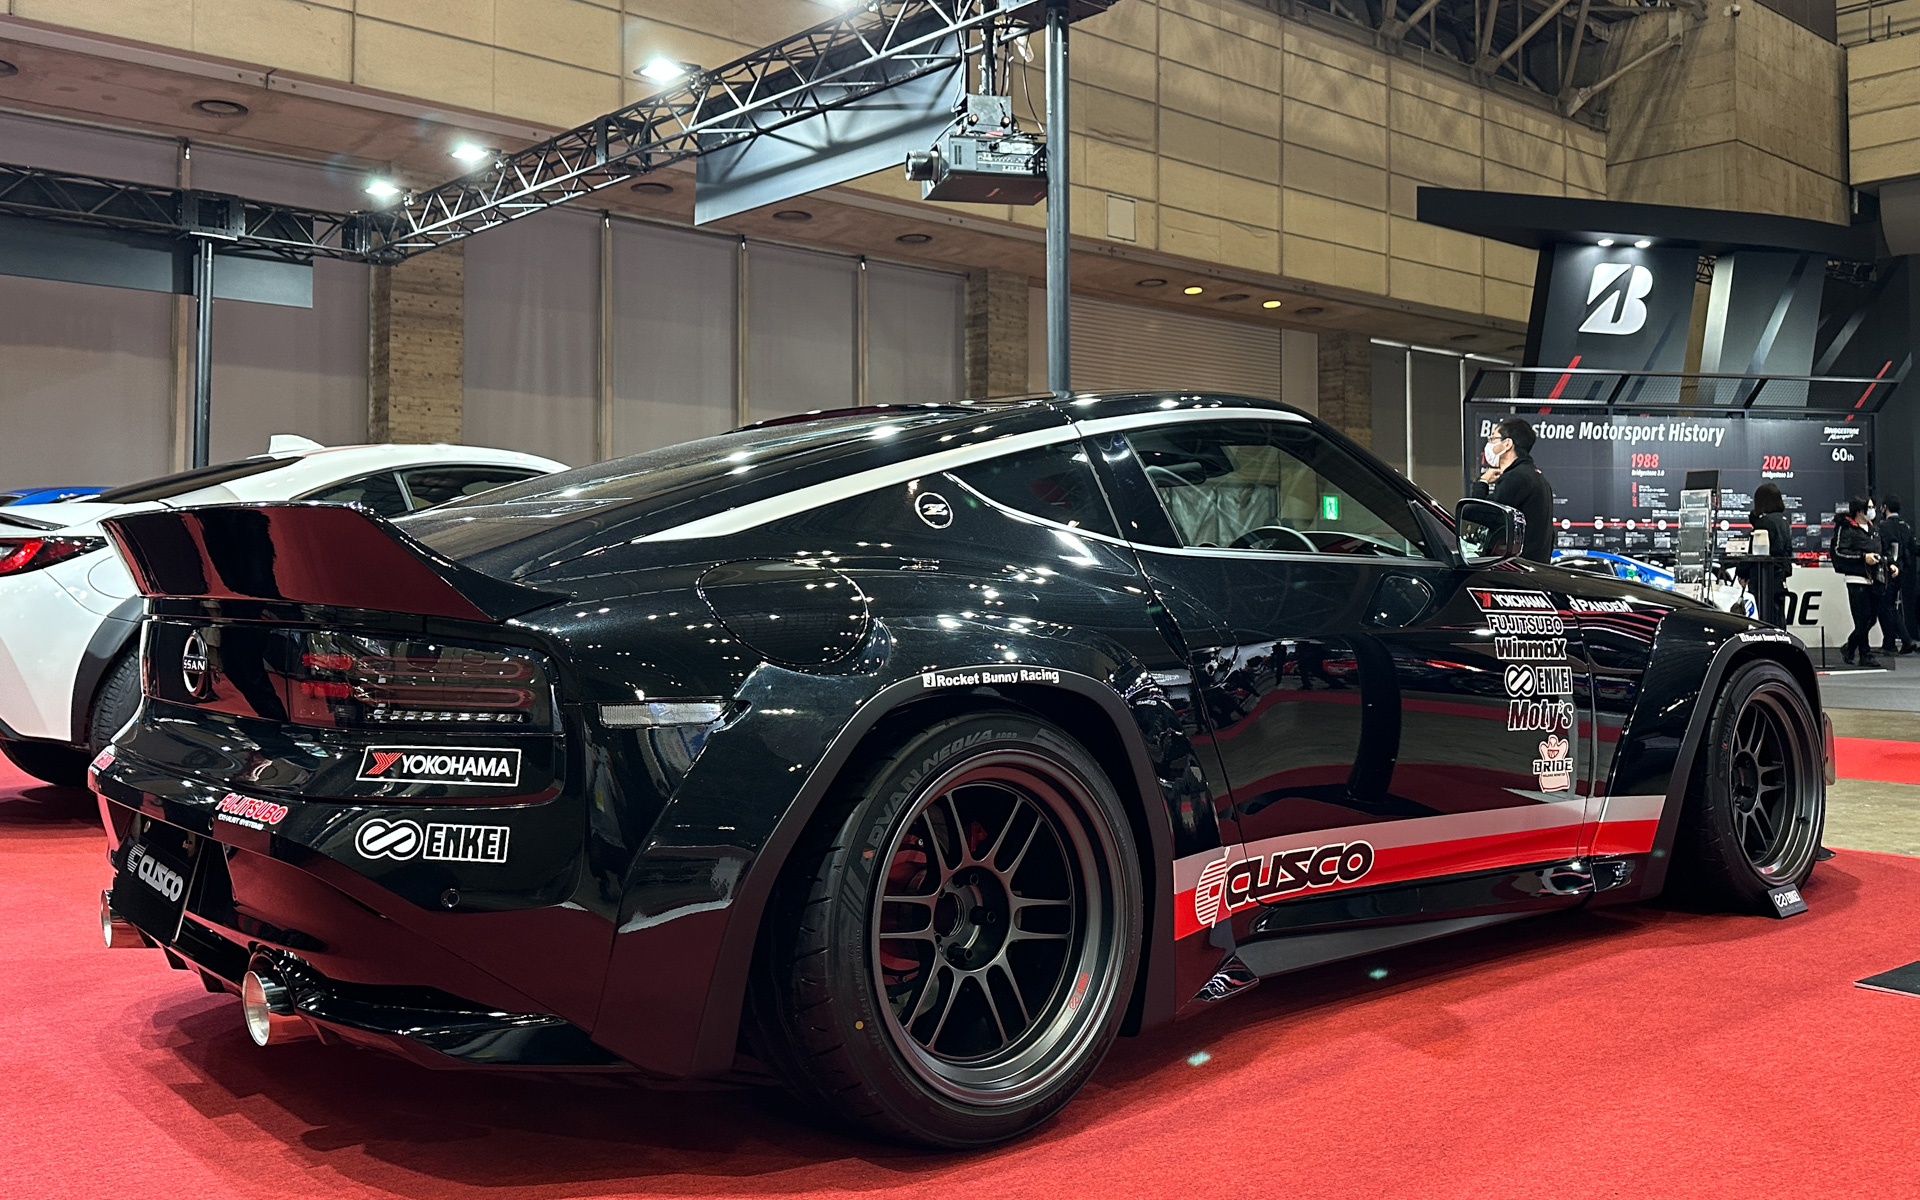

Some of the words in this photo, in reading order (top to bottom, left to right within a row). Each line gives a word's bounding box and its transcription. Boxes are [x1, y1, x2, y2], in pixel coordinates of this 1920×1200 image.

[1480, 419, 1574, 440] Brstone
[1578, 421, 1666, 446] Motorsport
[1668, 421, 1726, 448] History
[1630, 453, 1660, 468] 1988
[1762, 455, 1791, 470] 2020
[1831, 448, 1855, 462] 60th
[1492, 594, 1551, 609] YOKOHAMA
[1578, 599, 1634, 613] PANDEM
[1486, 614, 1564, 635] FUJITSUBO
[1494, 636, 1567, 660] WinmaX
[937, 673, 980, 687] Rocket
[982, 671, 1019, 685] Bunny
[1020, 668, 1060, 684] Racing
[1535, 666, 1573, 695] ENKEI
[1507, 698, 1574, 733] Moty's
[921, 729, 994, 774] NEOVA
[401, 754, 511, 778] YOKOHAMA
[1533, 757, 1574, 775] BRIDE
[215, 792, 289, 825] FUJITSUBO
[422, 823, 510, 863] ENKEI
[138, 854, 184, 902] CUSCO
[1225, 840, 1375, 910] CUSCO
